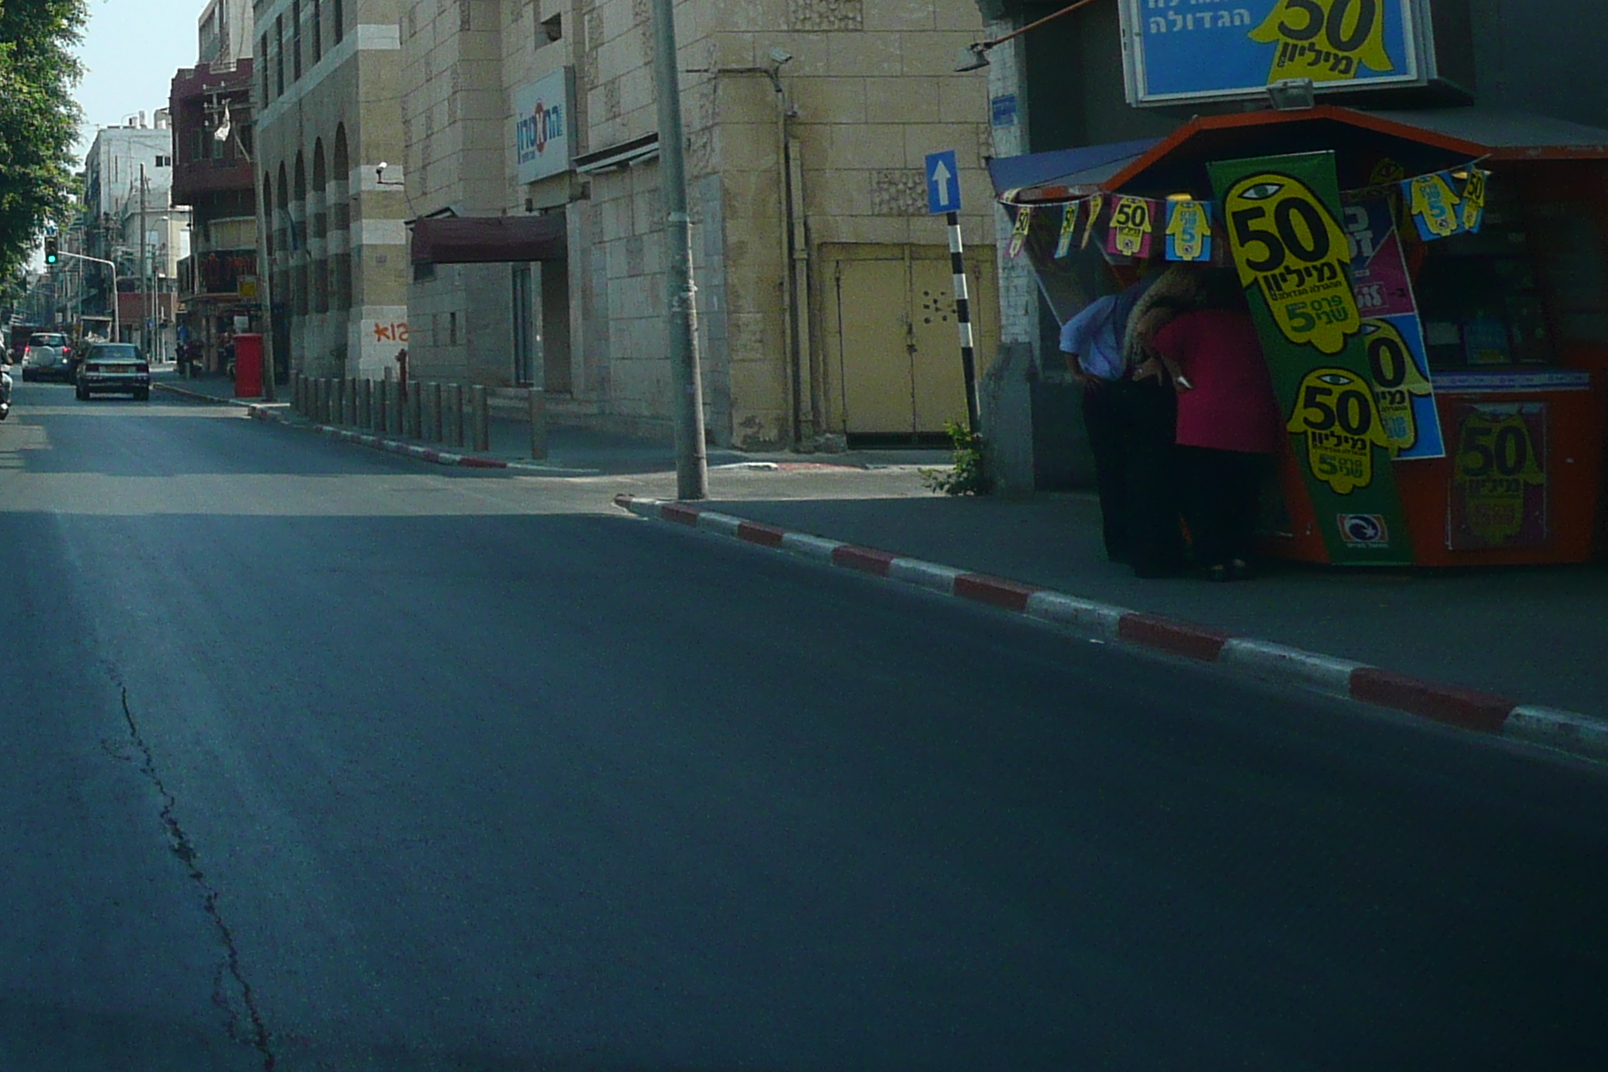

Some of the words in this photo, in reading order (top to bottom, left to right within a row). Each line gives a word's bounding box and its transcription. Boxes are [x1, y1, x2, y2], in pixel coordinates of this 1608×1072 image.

[1148, 8, 1251, 33] הגדולה
[1277, 40, 1354, 75] מיליון
[1116, 203, 1146, 227] 50
[1181, 226, 1195, 243] 5
[1231, 196, 1330, 272] 50
[1262, 261, 1338, 301] מיליון
[1285, 301, 1317, 333] 5
[1310, 294, 1343, 312] פרס
[1315, 305, 1349, 325] שני
[1370, 336, 1406, 389] 0
[1302, 385, 1372, 436] 50
[1311, 429, 1367, 451] מיליון
[1462, 425, 1528, 477] 50
[1318, 454, 1339, 476] 5
